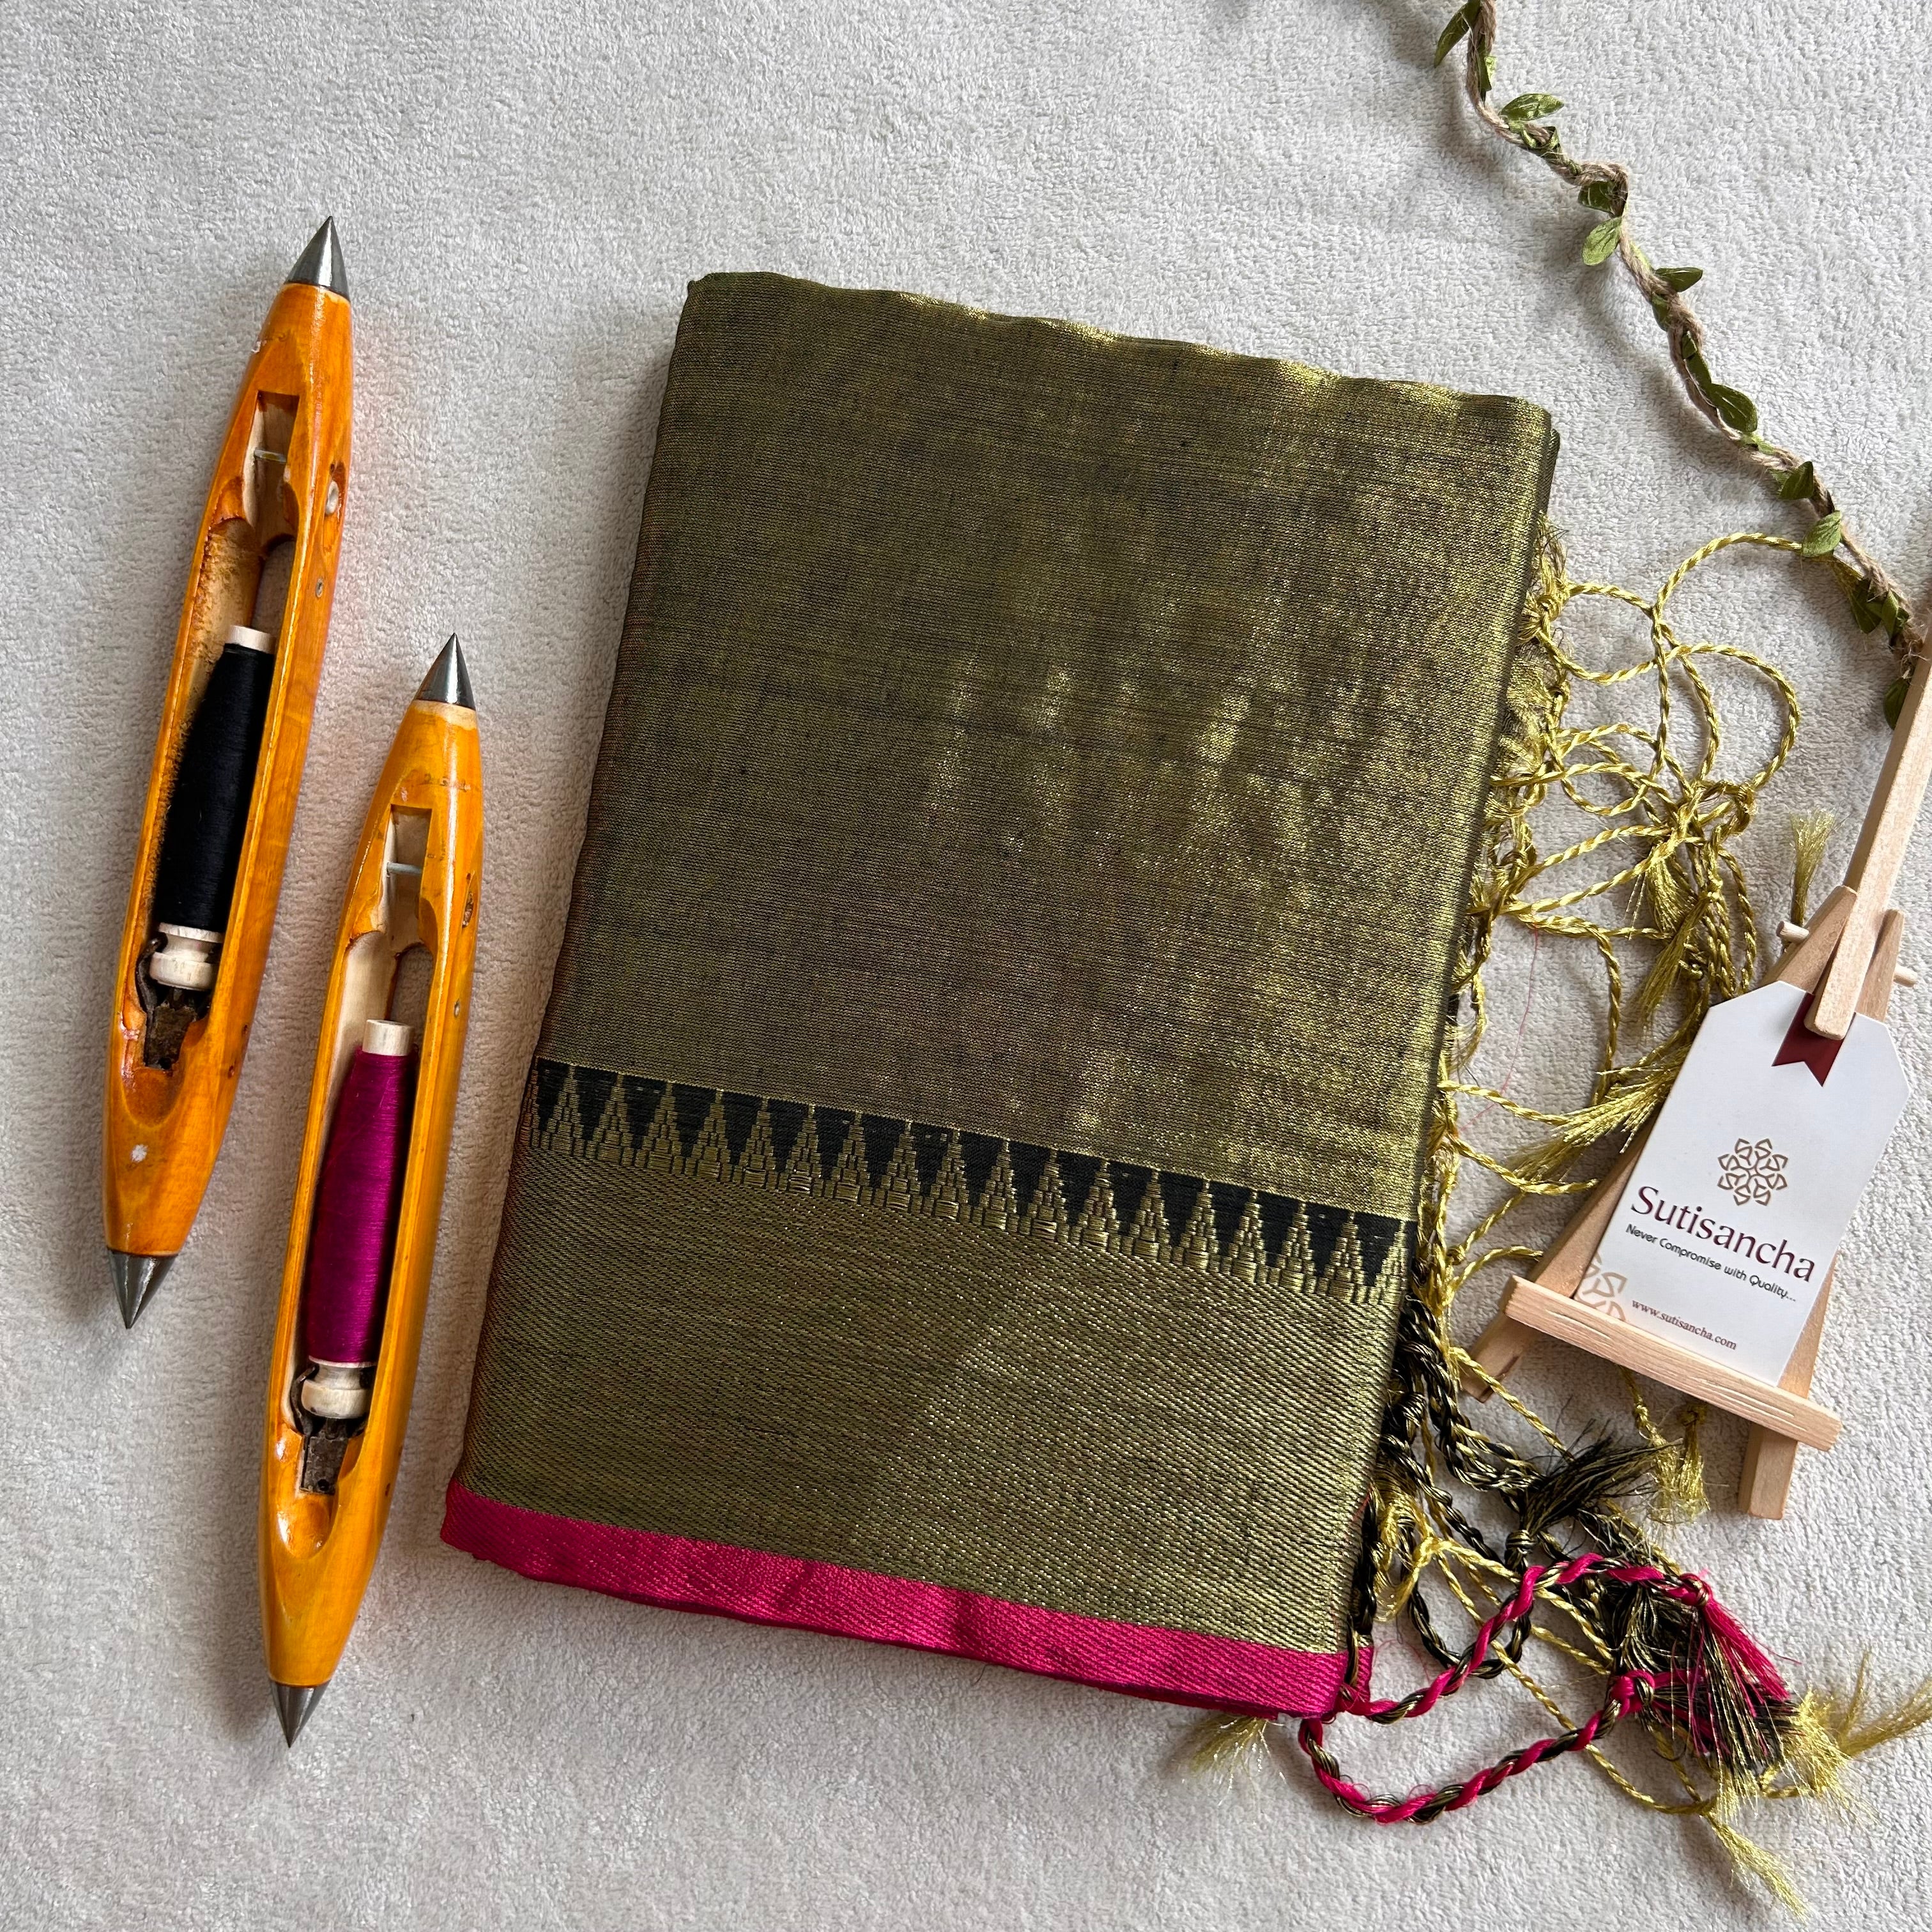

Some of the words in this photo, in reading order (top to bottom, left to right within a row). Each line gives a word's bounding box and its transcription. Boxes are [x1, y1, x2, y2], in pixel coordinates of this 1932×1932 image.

[1625, 1224, 1657, 1244] Never
[1659, 1238, 1722, 1271] Compromise
[1724, 1265, 1747, 1281] with
[1749, 1275, 1796, 1302] Quality...
[1630, 1186, 1815, 1282] Sutisancha
[1631, 1300, 1736, 1350] www.sutisancha.com
